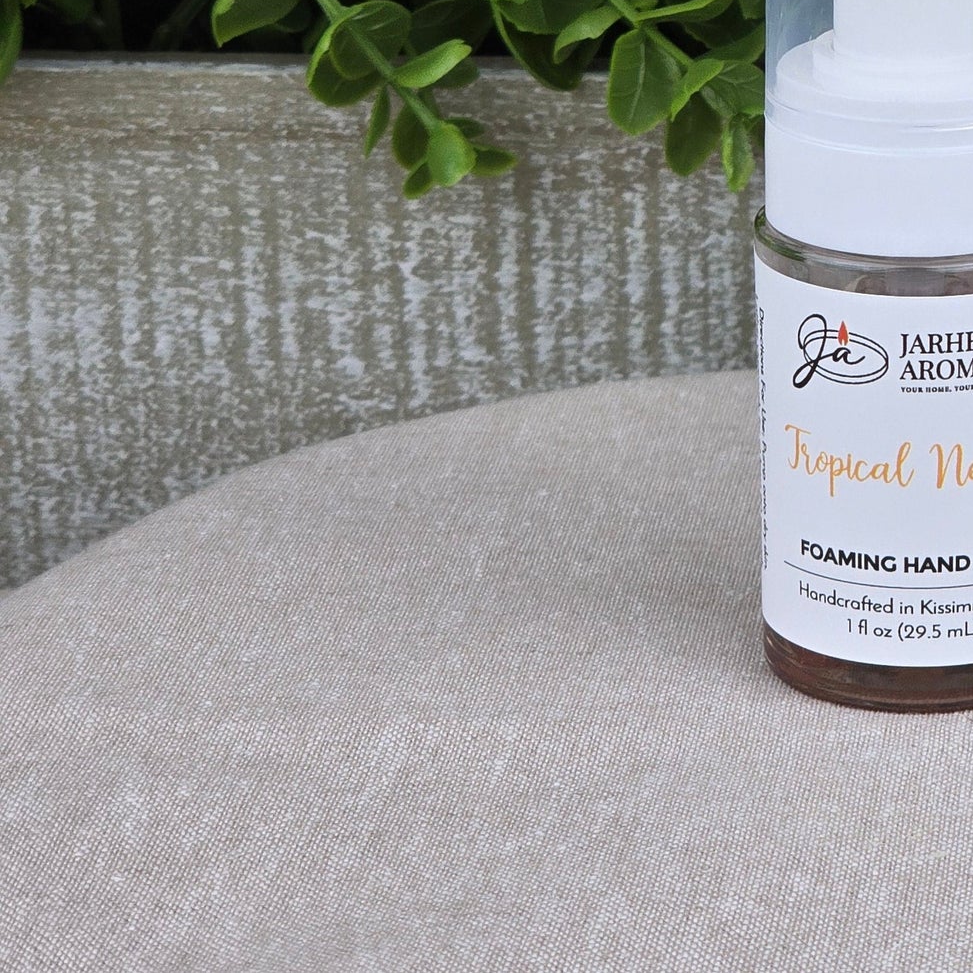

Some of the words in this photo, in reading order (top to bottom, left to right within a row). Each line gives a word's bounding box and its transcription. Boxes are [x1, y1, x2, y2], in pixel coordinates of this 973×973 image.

[784, 424, 914, 497] Tropical
[800, 539, 897, 573] FOAMING
[903, 555, 971, 573] HAND
[799, 580, 894, 615] Handcrafted
[899, 602, 914, 614] in
[847, 619, 852, 633] 1
[857, 619, 868, 635] fl
[873, 627, 893, 638] oz
[897, 625, 942, 642] (29.5
